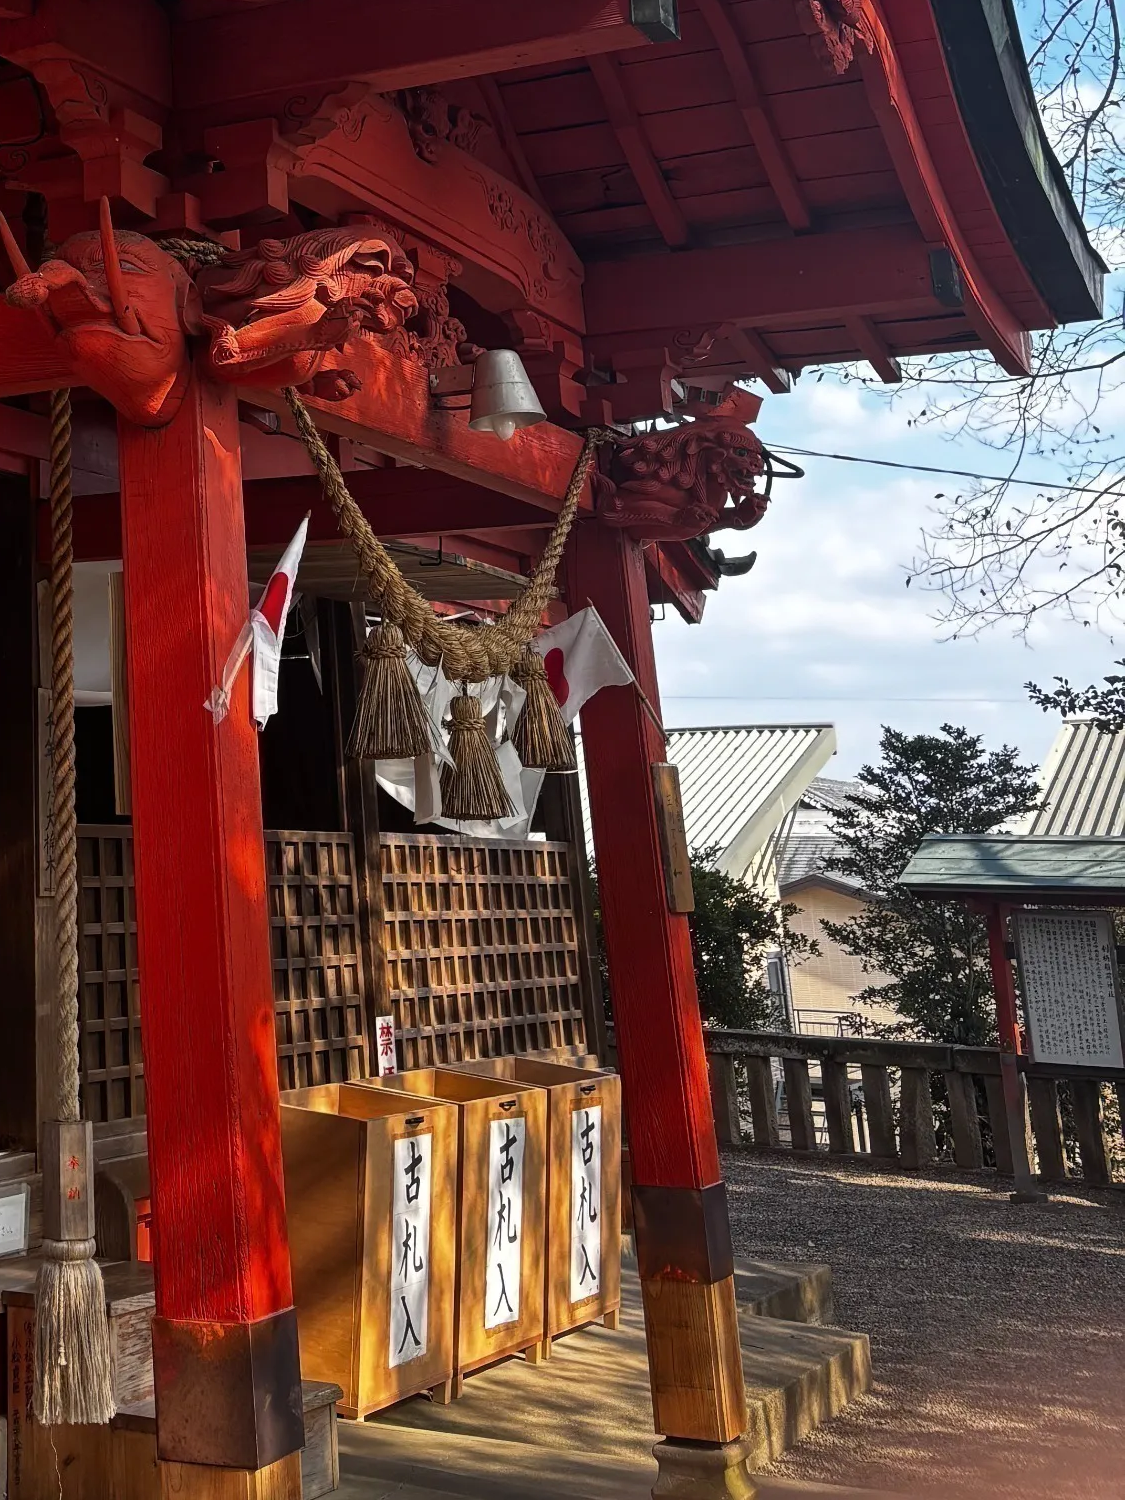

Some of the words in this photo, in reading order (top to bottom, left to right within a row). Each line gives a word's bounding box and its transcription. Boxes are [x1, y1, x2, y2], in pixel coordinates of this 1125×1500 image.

[397, 1140, 424, 1356] 古札入
[493, 1122, 518, 1318] 古札入
[577, 1110, 598, 1286] 古札入
